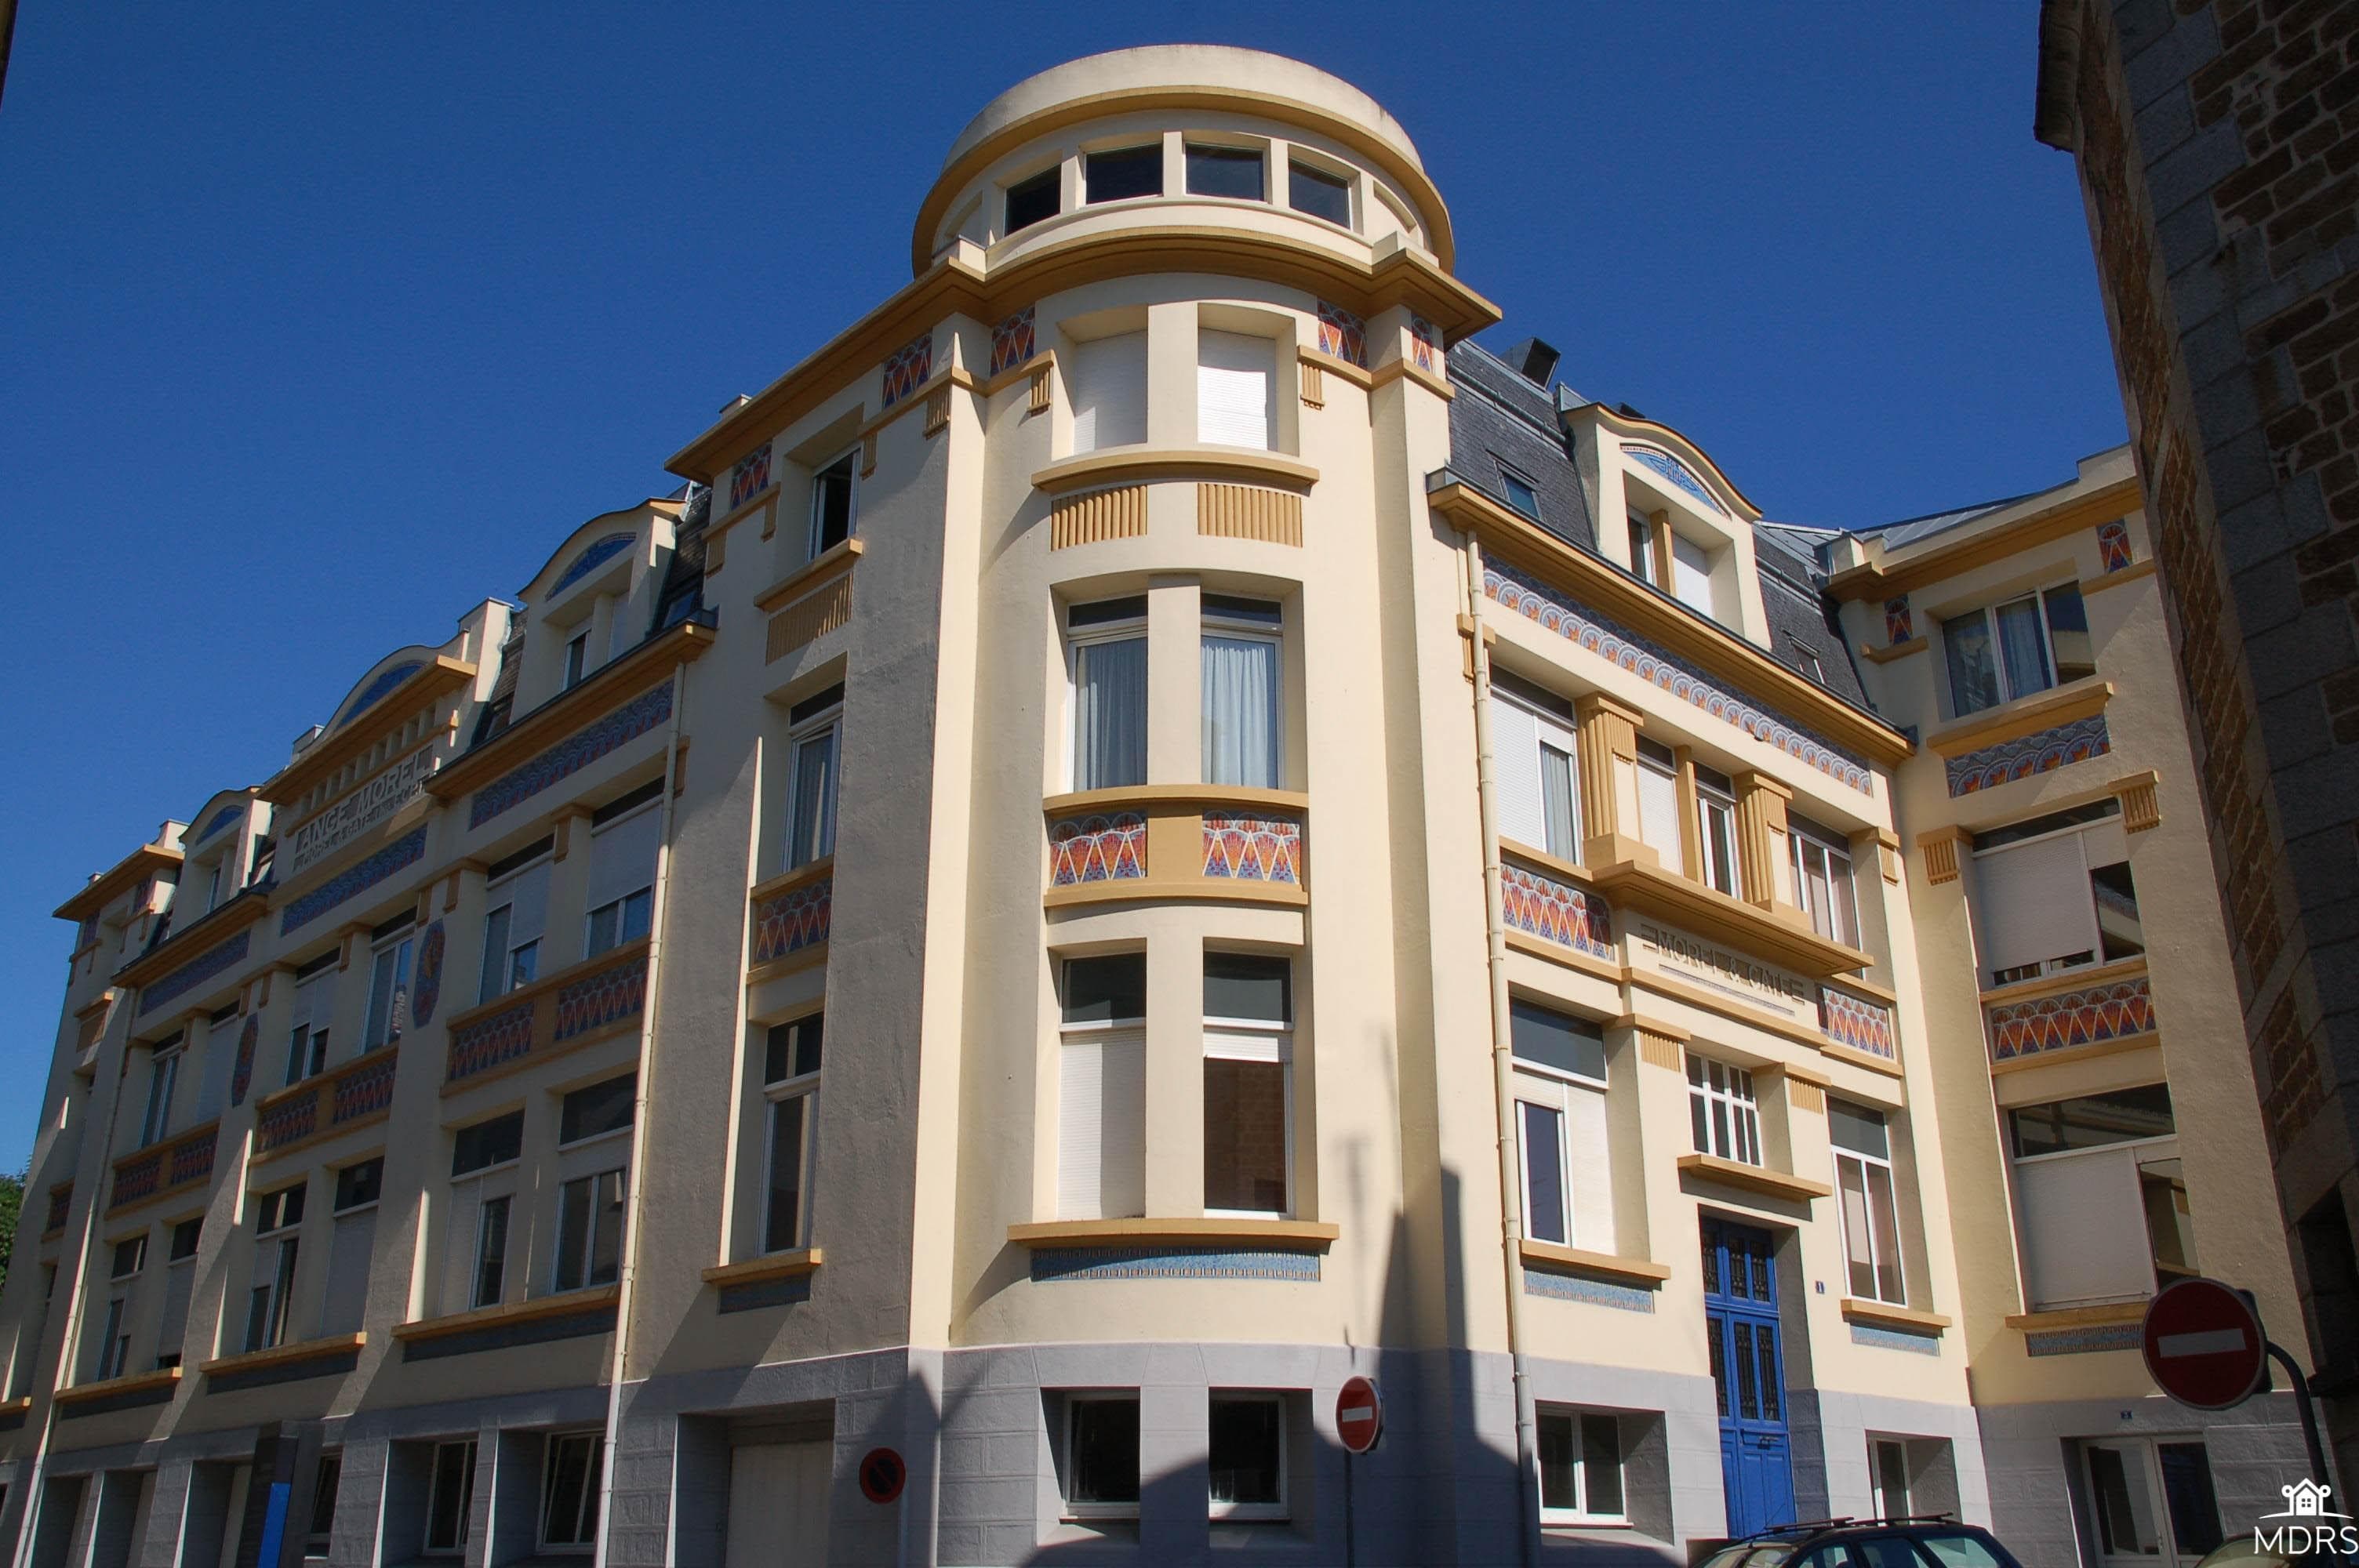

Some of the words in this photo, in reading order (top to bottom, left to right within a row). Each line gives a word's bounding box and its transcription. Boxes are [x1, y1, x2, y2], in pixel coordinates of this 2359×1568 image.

[301, 803, 349, 849] ANGE
[357, 750, 429, 812] MOREL
[1658, 929, 1722, 975] MOREL
[1728, 956, 1740, 982] &
